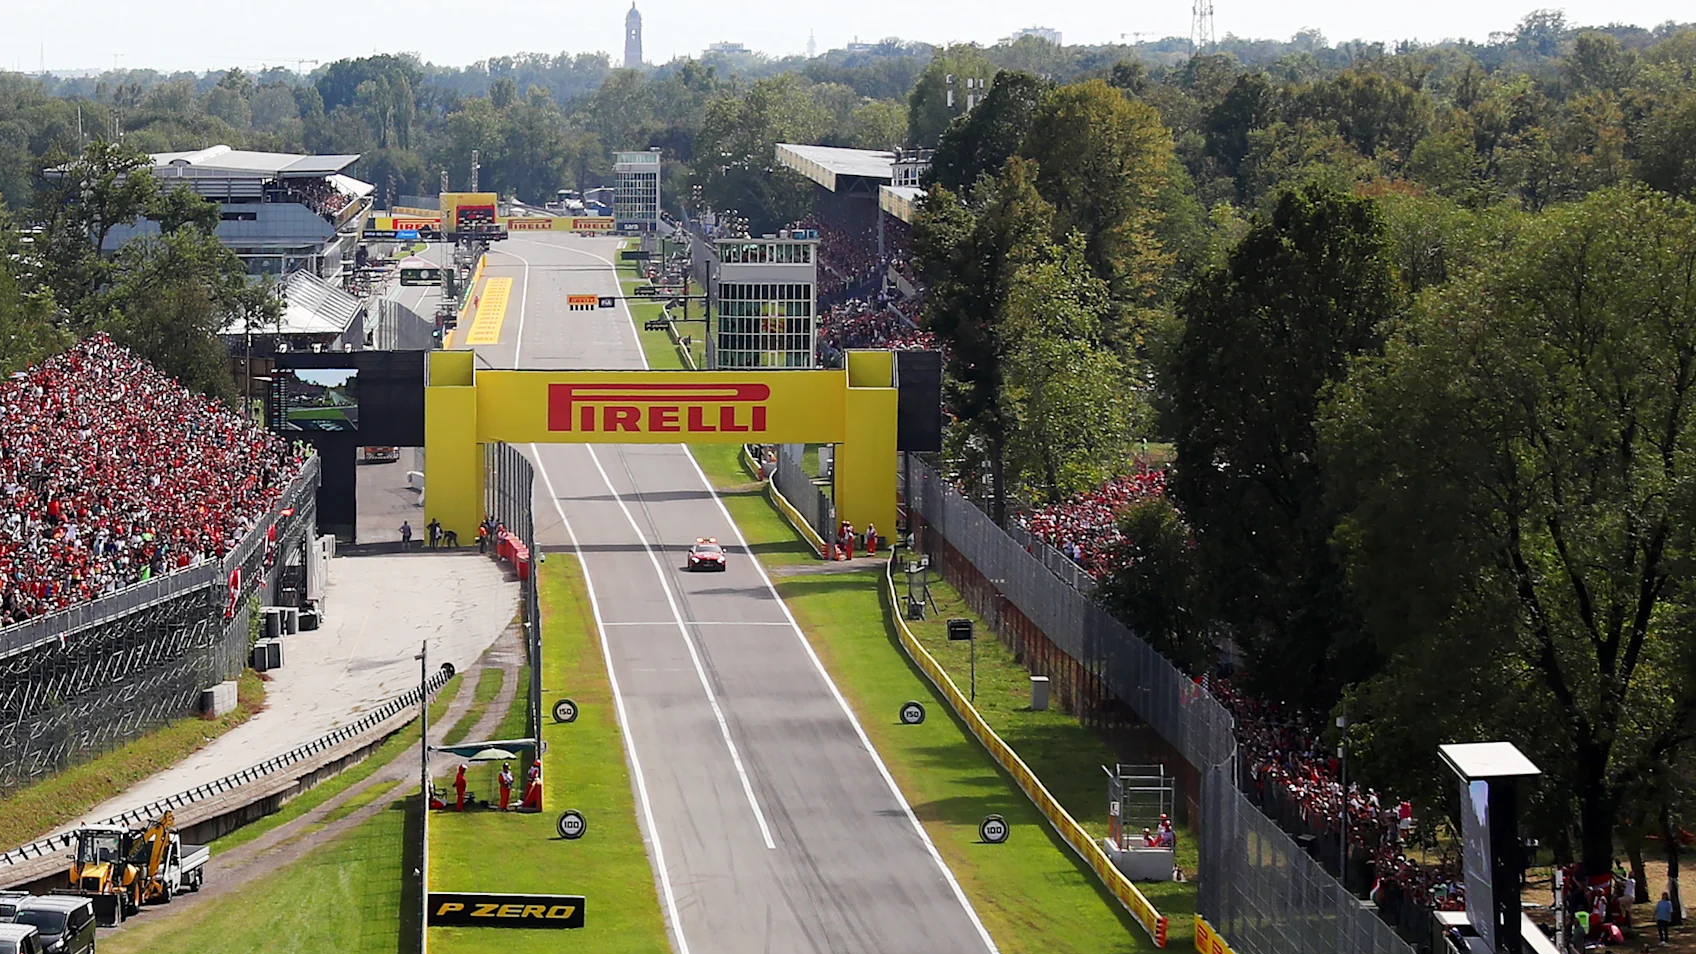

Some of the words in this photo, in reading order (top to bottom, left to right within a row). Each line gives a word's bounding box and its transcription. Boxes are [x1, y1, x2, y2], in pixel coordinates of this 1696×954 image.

[508, 219, 552, 230] PIRELLI
[548, 383, 770, 432] PIRELLI
[559, 707, 572, 715] 150
[906, 710, 919, 718] 150
[564, 820, 579, 828] 100
[437, 903, 464, 916] P
[471, 903, 575, 918] ZERO
